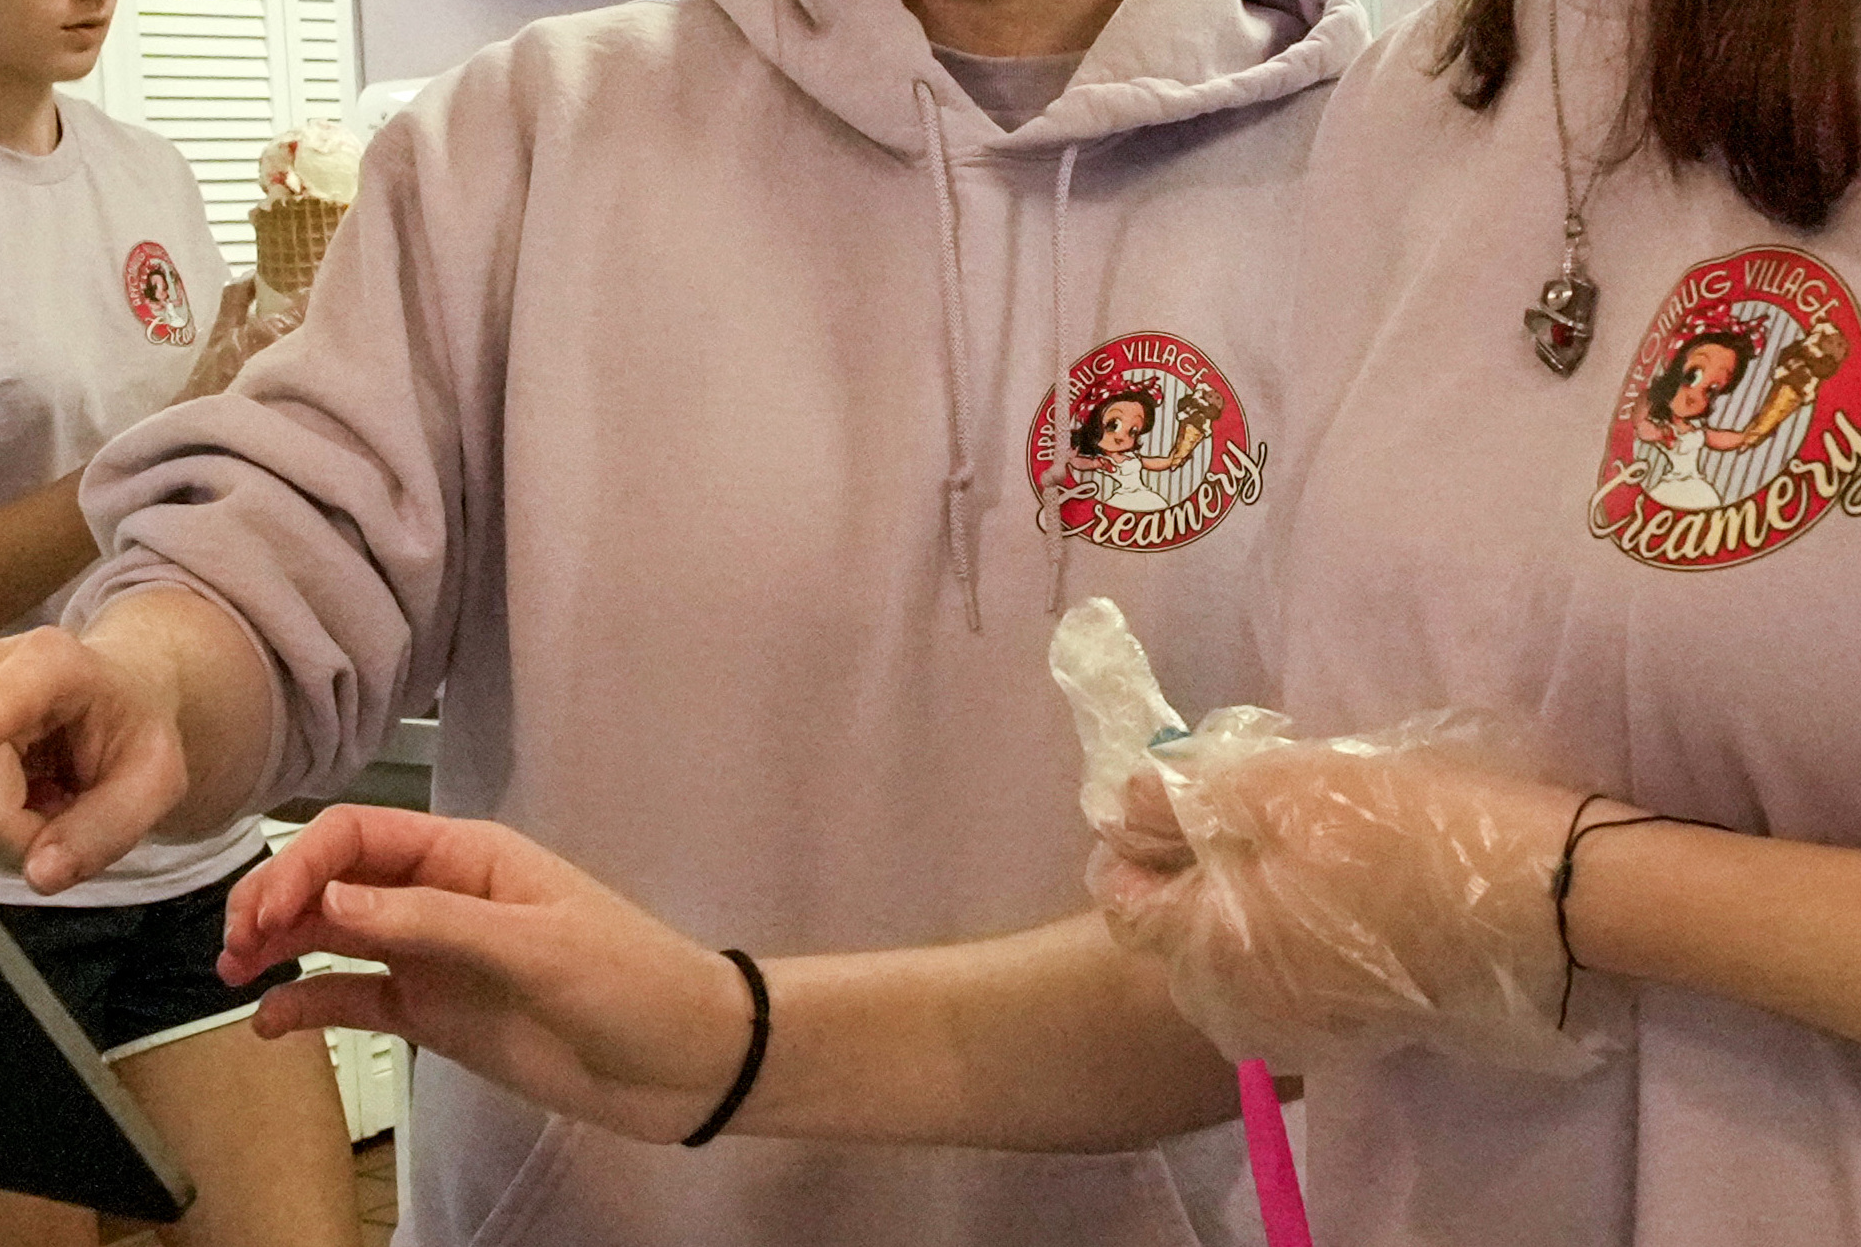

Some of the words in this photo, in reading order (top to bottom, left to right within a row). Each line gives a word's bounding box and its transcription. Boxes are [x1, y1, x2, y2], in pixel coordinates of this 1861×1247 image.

[1743, 258, 1840, 326] VILLAGE
[1122, 340, 1208, 385] VILLAGE
[1037, 439, 1268, 546] Creamery
